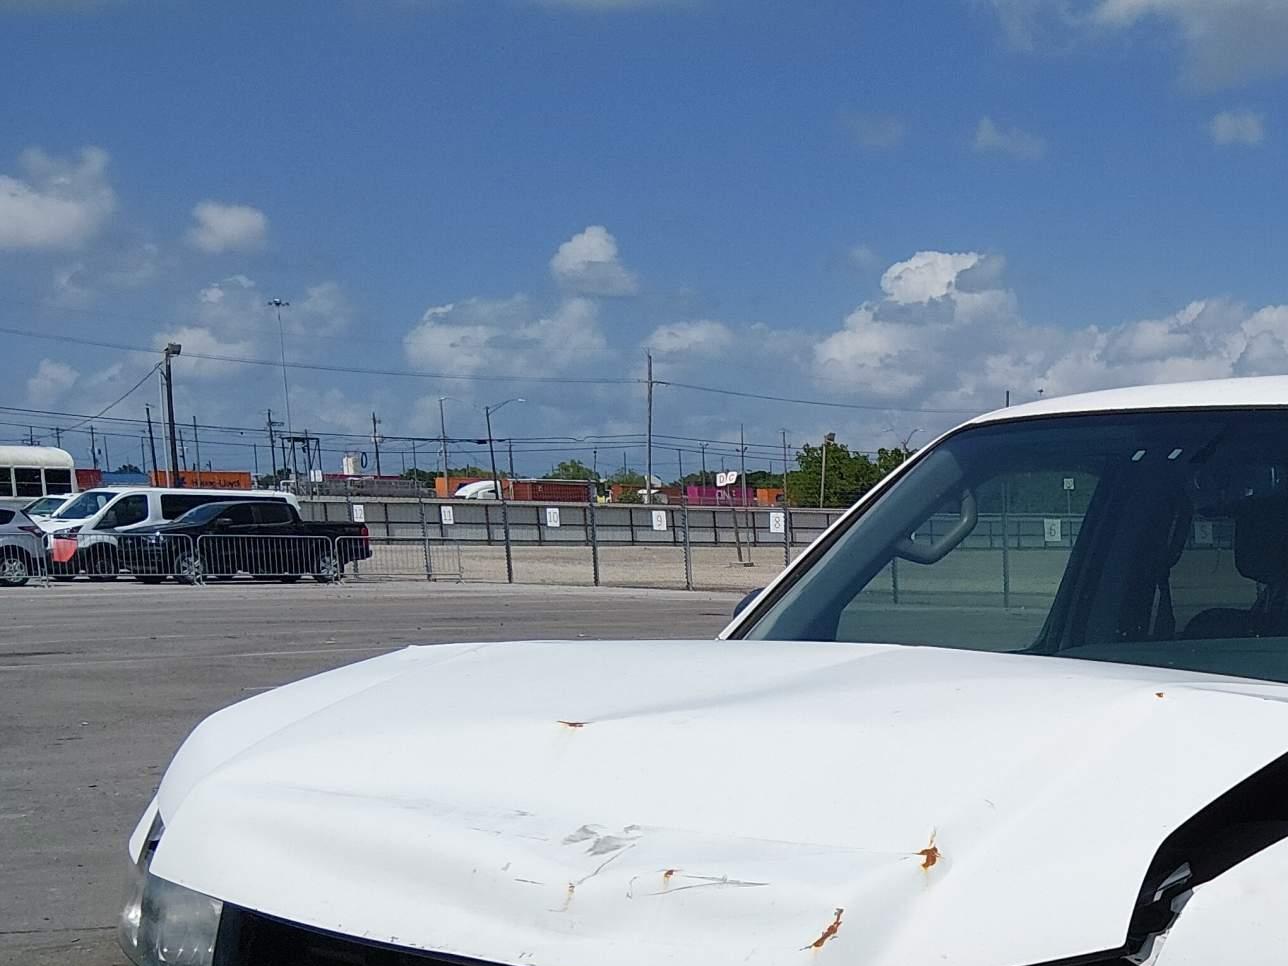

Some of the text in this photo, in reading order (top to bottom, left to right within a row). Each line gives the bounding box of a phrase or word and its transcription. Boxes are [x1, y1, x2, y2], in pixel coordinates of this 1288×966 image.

[354, 507, 364, 520] 12
[443, 508, 452, 521] 11
[547, 511, 559, 523] 10
[656, 514, 663, 527] 9
[774, 516, 781, 529] 8
